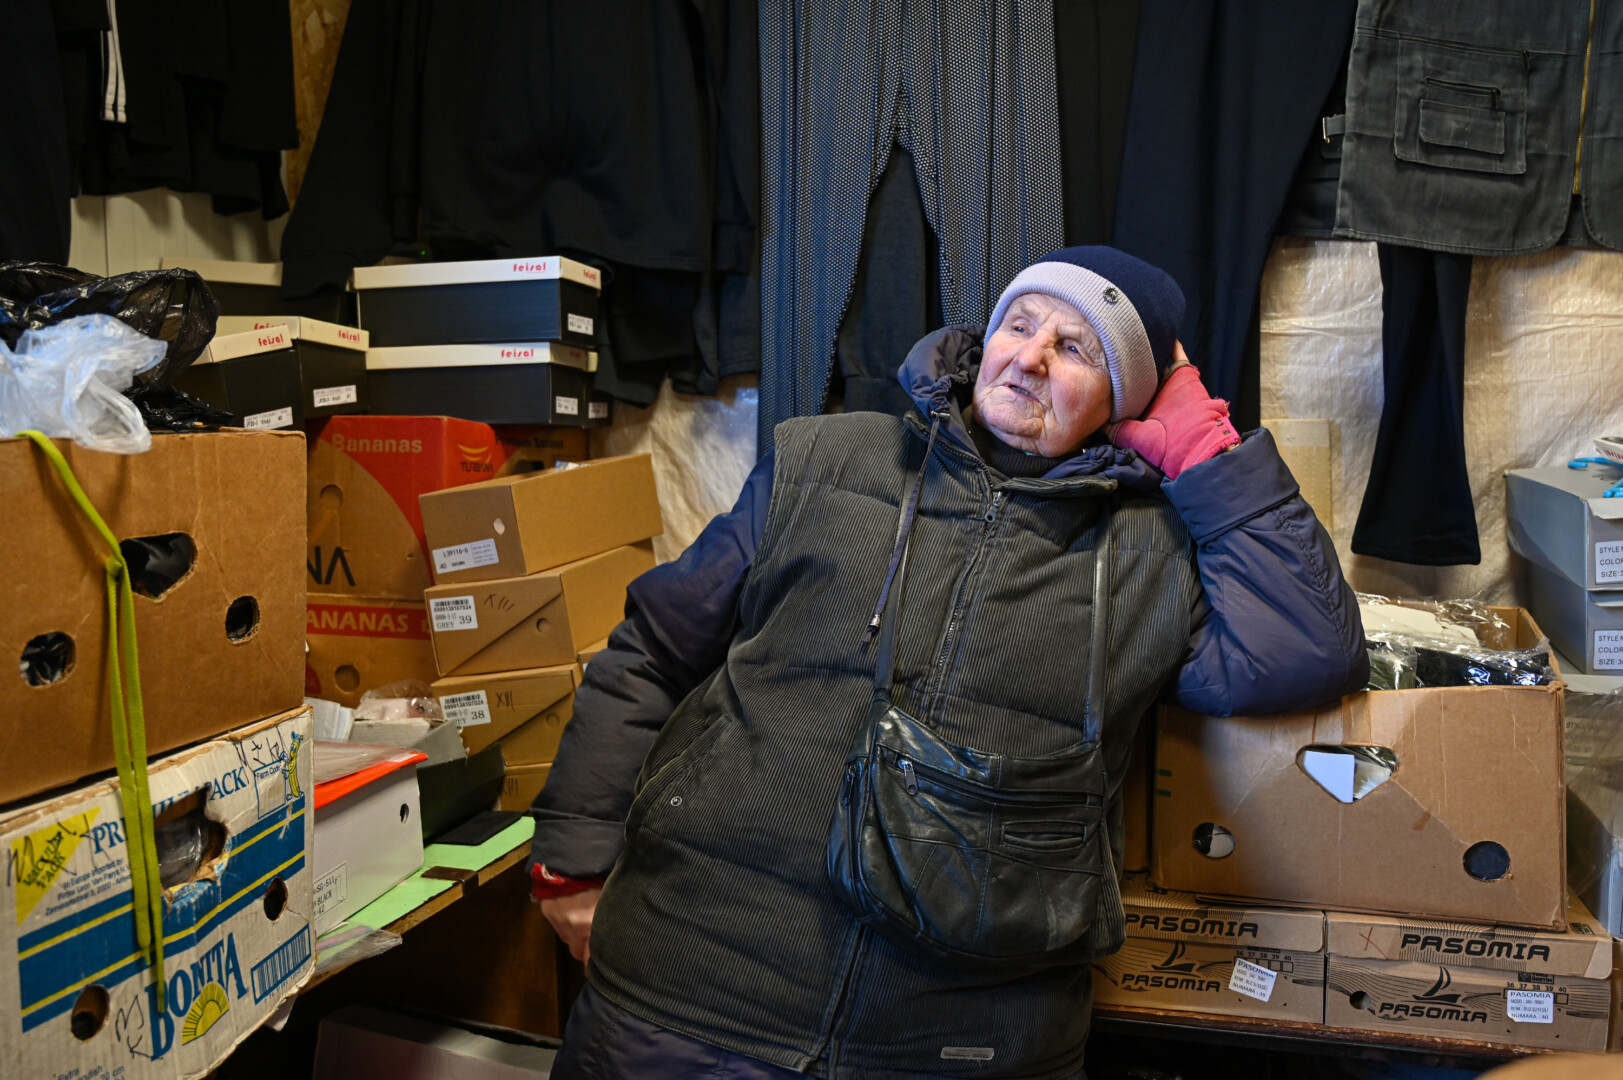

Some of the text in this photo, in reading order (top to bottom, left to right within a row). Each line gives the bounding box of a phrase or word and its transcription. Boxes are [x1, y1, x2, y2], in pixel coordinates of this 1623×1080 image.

[513, 262, 546, 272] feisal
[258, 333, 284, 347] feisal
[501, 348, 534, 358] feisal
[332, 433, 423, 453] Bananas
[1599, 546, 1620, 554] STYLE
[459, 615, 472, 625] 39
[471, 710, 485, 720] 38
[1125, 914, 1259, 938] PASOMIA
[1401, 933, 1551, 962] PASOMIA
[1121, 973, 1221, 993] PASOMIA
[1233, 982, 1256, 994] NUMARA
[144, 932, 249, 1062] BONITA
[1379, 1002, 1488, 1023] PASOMIA
